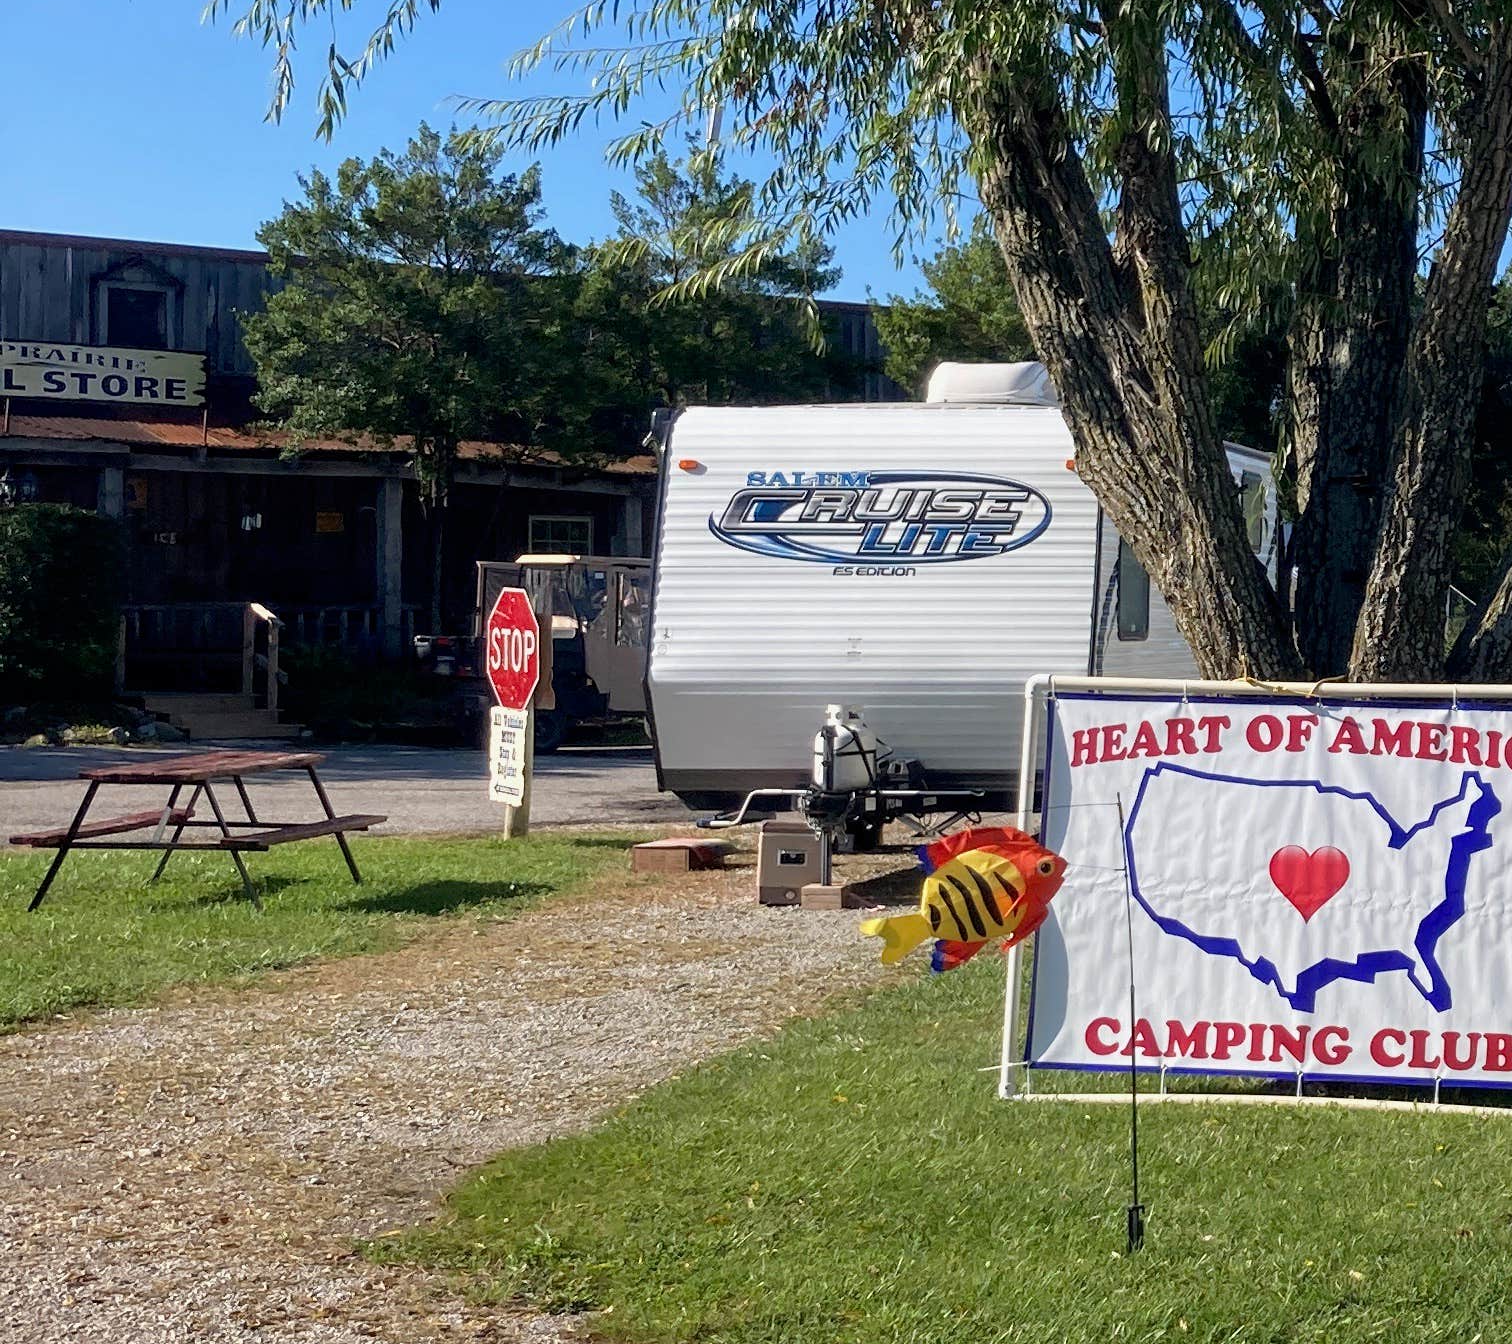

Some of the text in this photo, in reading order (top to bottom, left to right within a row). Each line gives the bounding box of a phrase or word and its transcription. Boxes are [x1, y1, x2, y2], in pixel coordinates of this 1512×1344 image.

[42, 370, 187, 401] STORE
[746, 471, 871, 487] SALEM
[719, 488, 1030, 535] CRUISE
[856, 522, 1015, 556] LITE
[490, 626, 536, 674] STOP
[1070, 715, 1231, 767] HEART
[1244, 714, 1320, 753] OF
[1084, 1016, 1353, 1066] CAMPING
